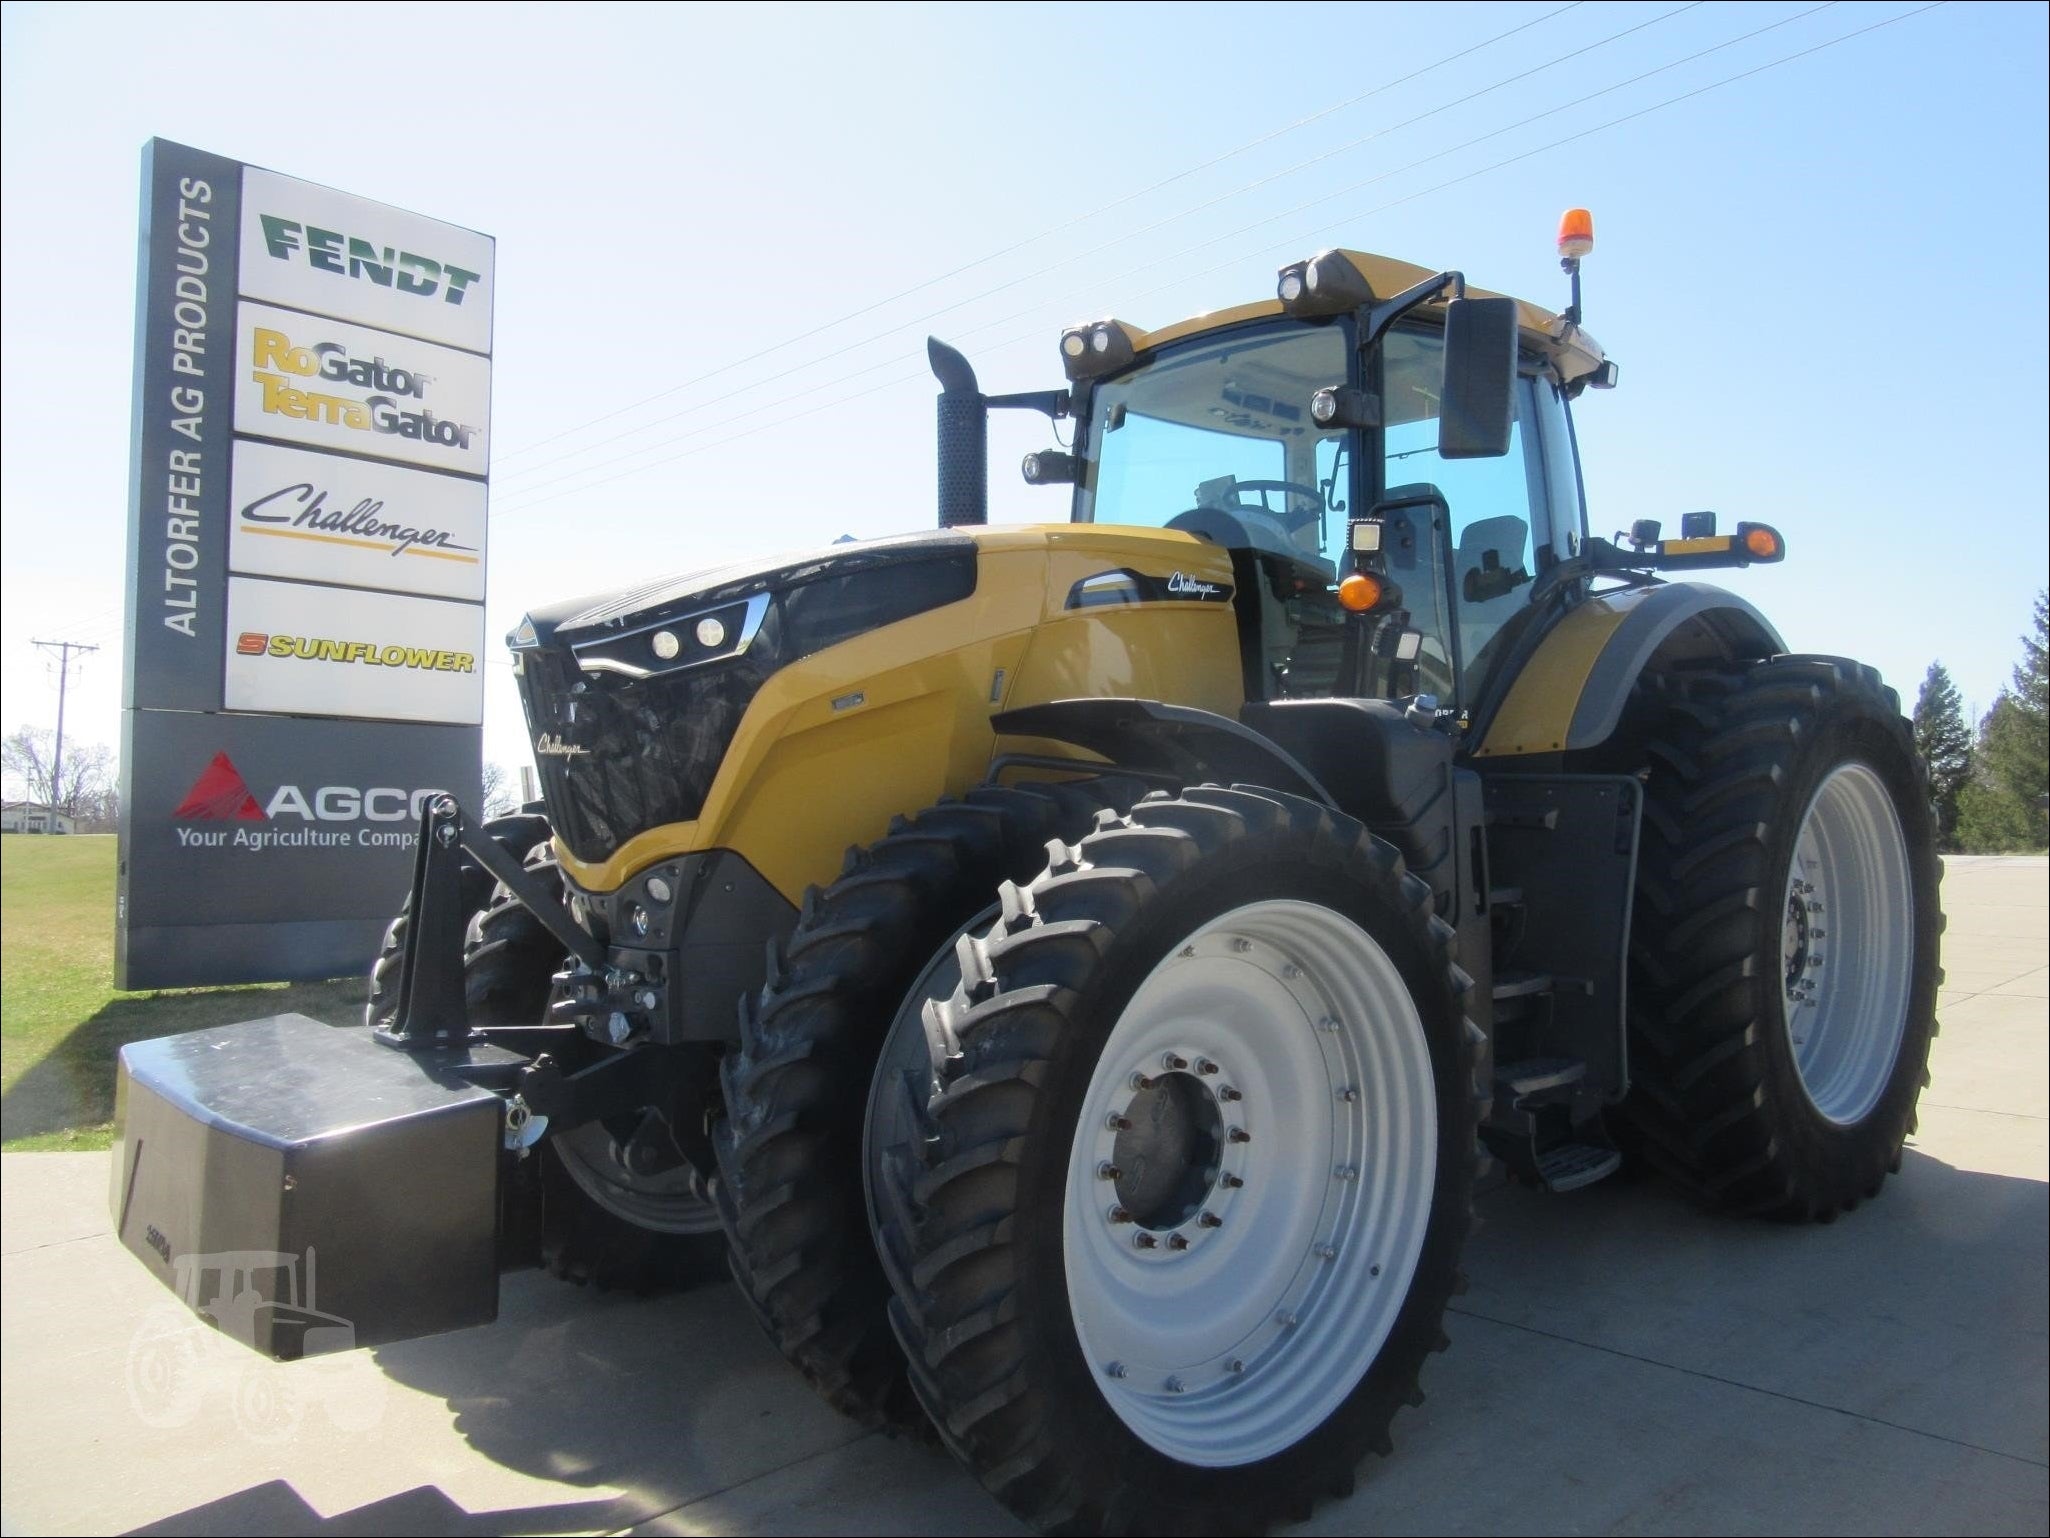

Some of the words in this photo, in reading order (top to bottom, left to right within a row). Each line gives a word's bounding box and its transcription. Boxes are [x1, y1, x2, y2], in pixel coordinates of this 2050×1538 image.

[173, 177, 212, 376] PRODUCTS
[259, 213, 481, 306] FENDT
[253, 327, 432, 399] RoGator
[171, 386, 204, 442] AG
[252, 371, 477, 450] TerraGator
[164, 449, 201, 637] ALTORFER
[241, 483, 479, 557] Challenger
[1167, 571, 1221, 600] Challenger
[268, 635, 475, 674] SUNFLOWER
[537, 732, 591, 762] Challenger
[177, 828, 228, 847] Your
[233, 827, 351, 851] Agriculture
[358, 829, 420, 850] Compa
